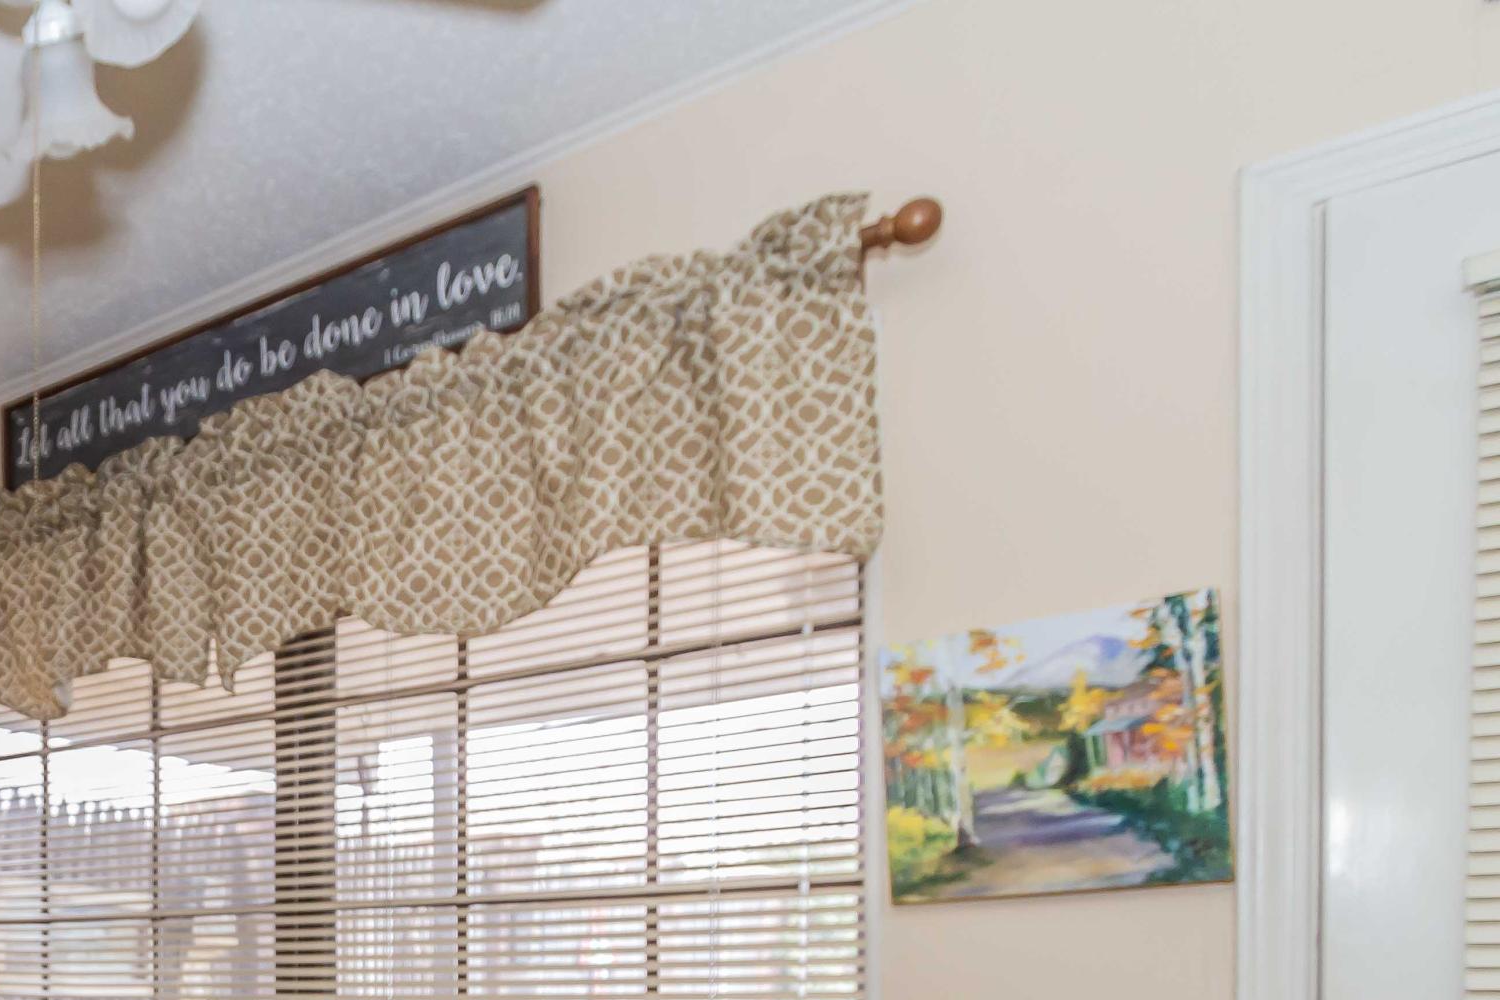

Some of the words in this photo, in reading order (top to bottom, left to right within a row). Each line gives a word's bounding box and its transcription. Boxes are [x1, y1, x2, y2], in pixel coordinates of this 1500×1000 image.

[56, 404, 94, 449] all
[99, 382, 156, 437] that
[160, 375, 210, 425] you
[216, 349, 252, 392] do
[259, 335, 298, 376] be
[303, 306, 383, 360] done
[390, 287, 430, 328] in
